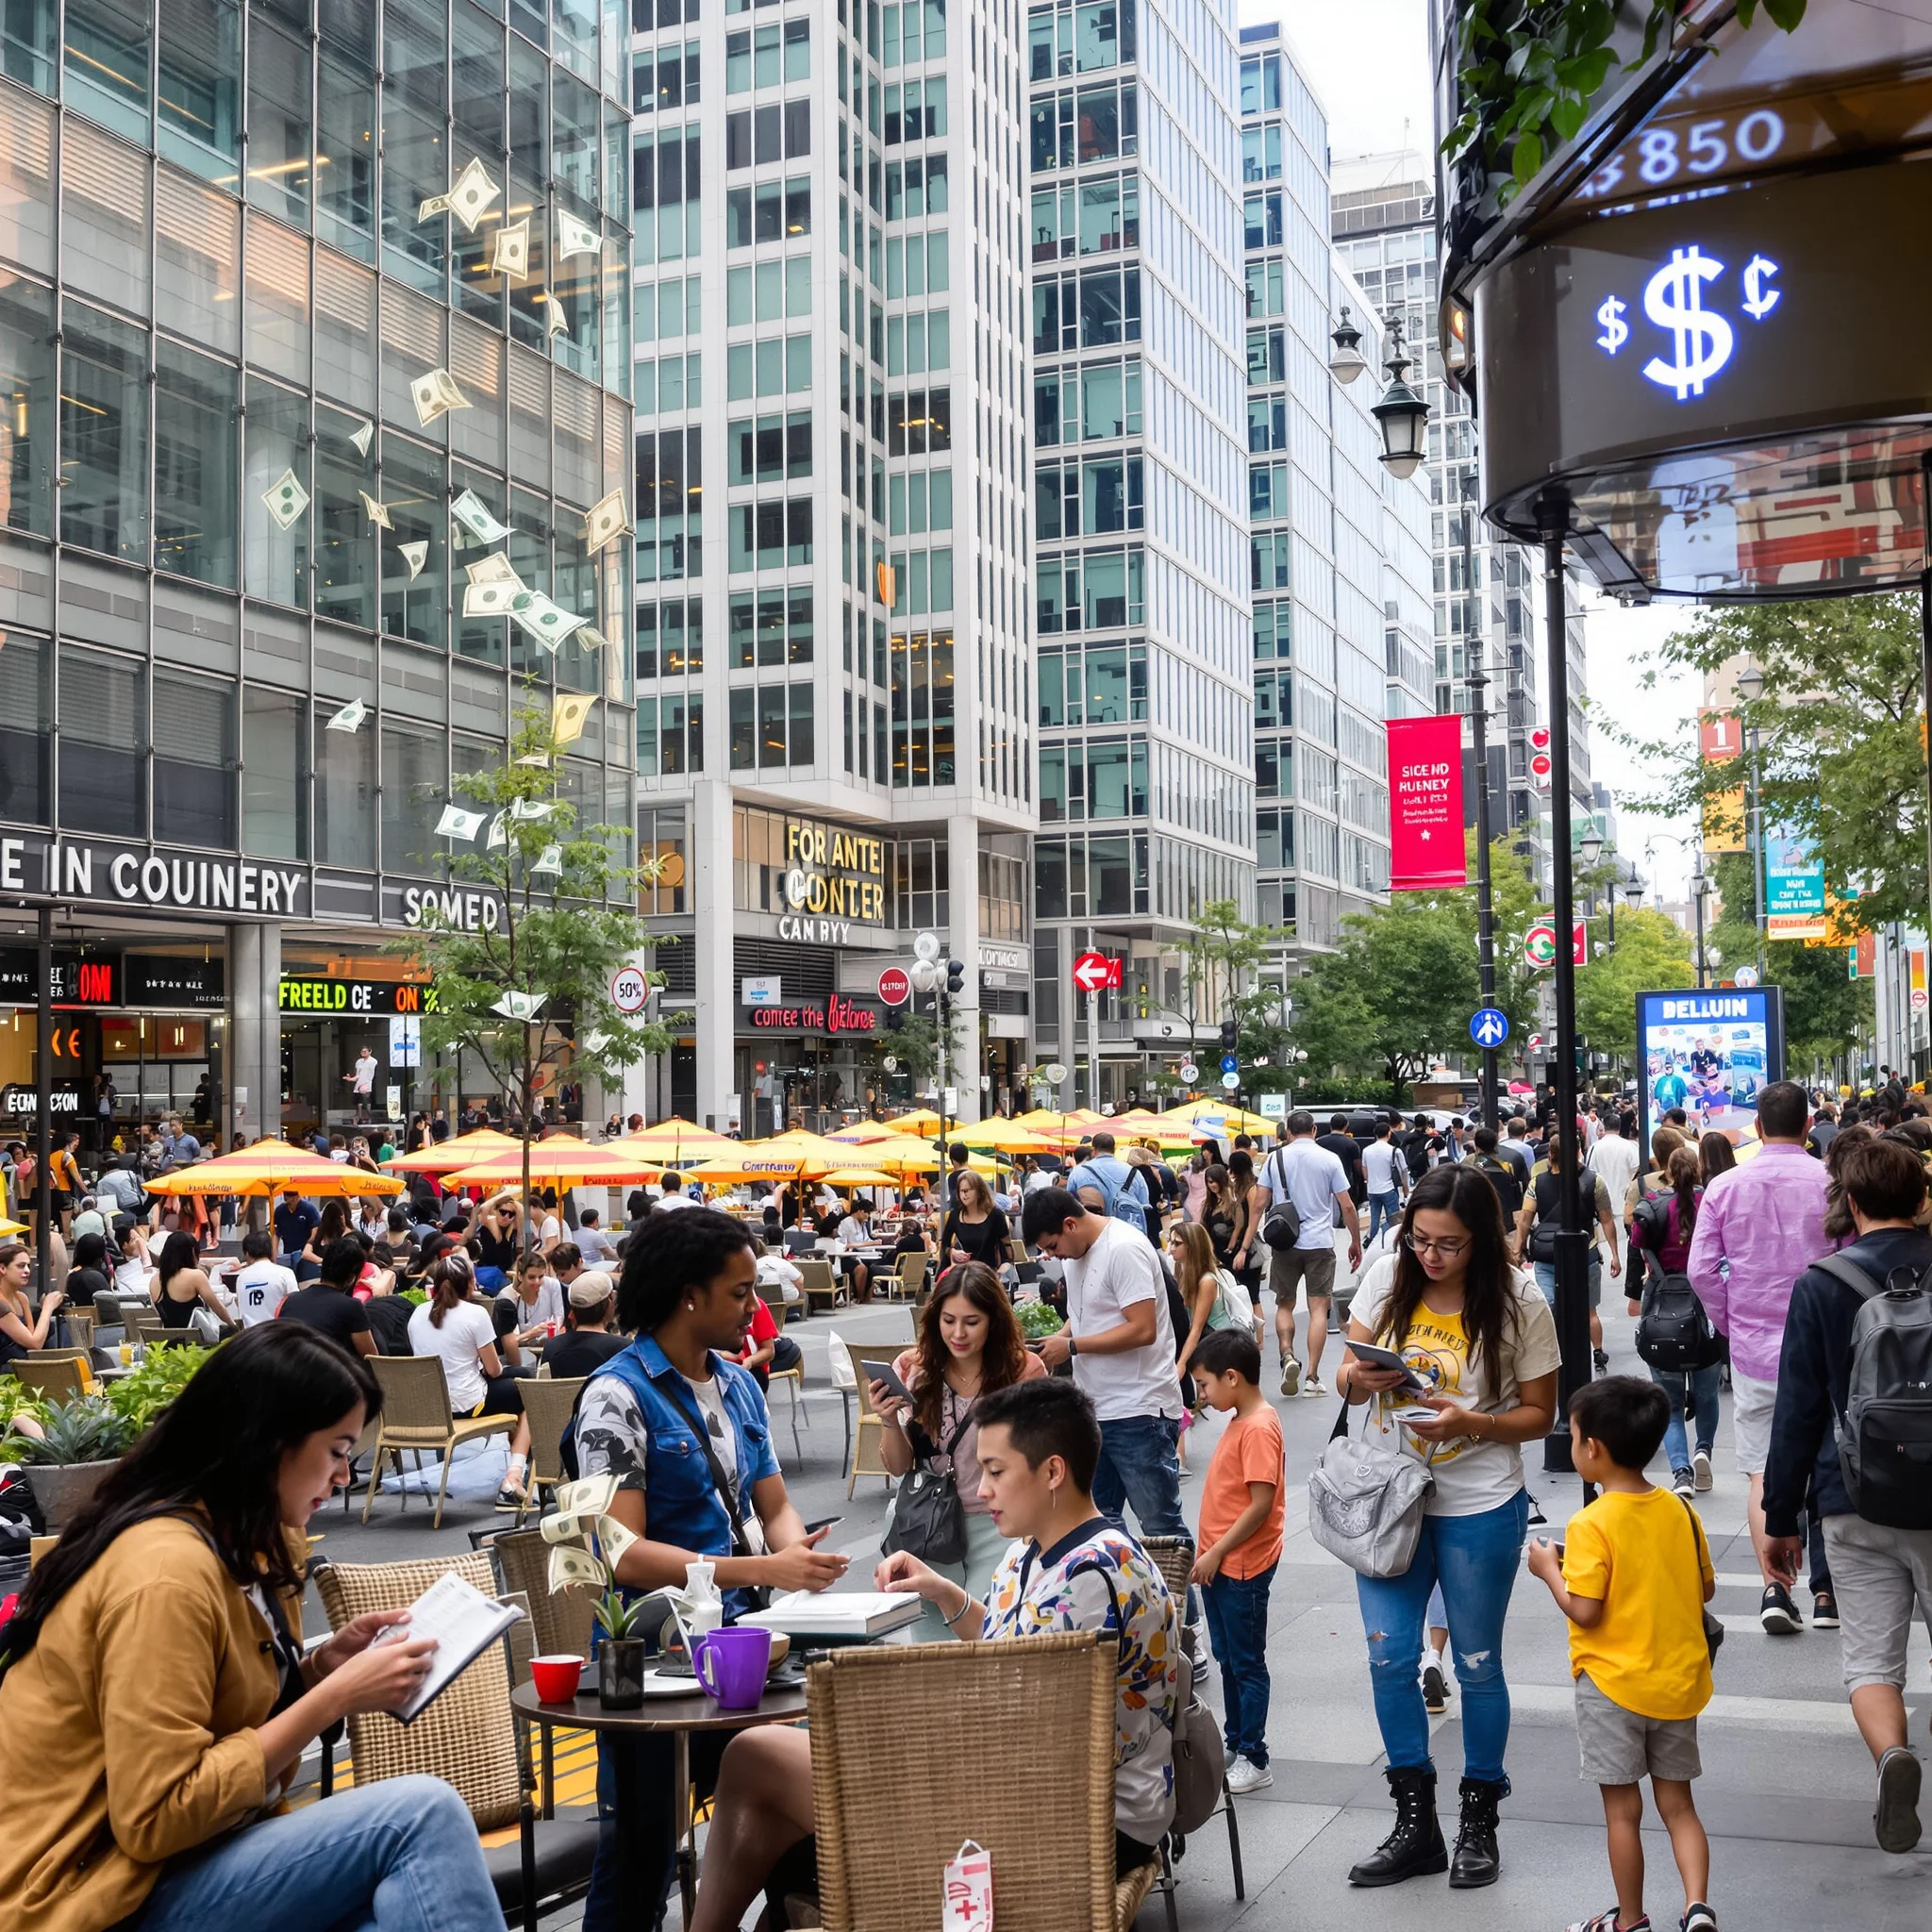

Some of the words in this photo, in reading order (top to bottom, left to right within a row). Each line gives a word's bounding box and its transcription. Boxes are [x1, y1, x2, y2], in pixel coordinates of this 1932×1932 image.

[1596, 295, 1629, 355] $
[1642, 245, 1734, 400] $
[1713, 719, 1726, 745] 1
[788, 824, 826, 865] FOR
[43, 844, 92, 894] IN
[110, 853, 301, 913] COUINERY
[404, 887, 498, 932] SOMED
[279, 983, 346, 1009] FREELD
[352, 985, 373, 1010] CE
[395, 987, 419, 1012] ON
